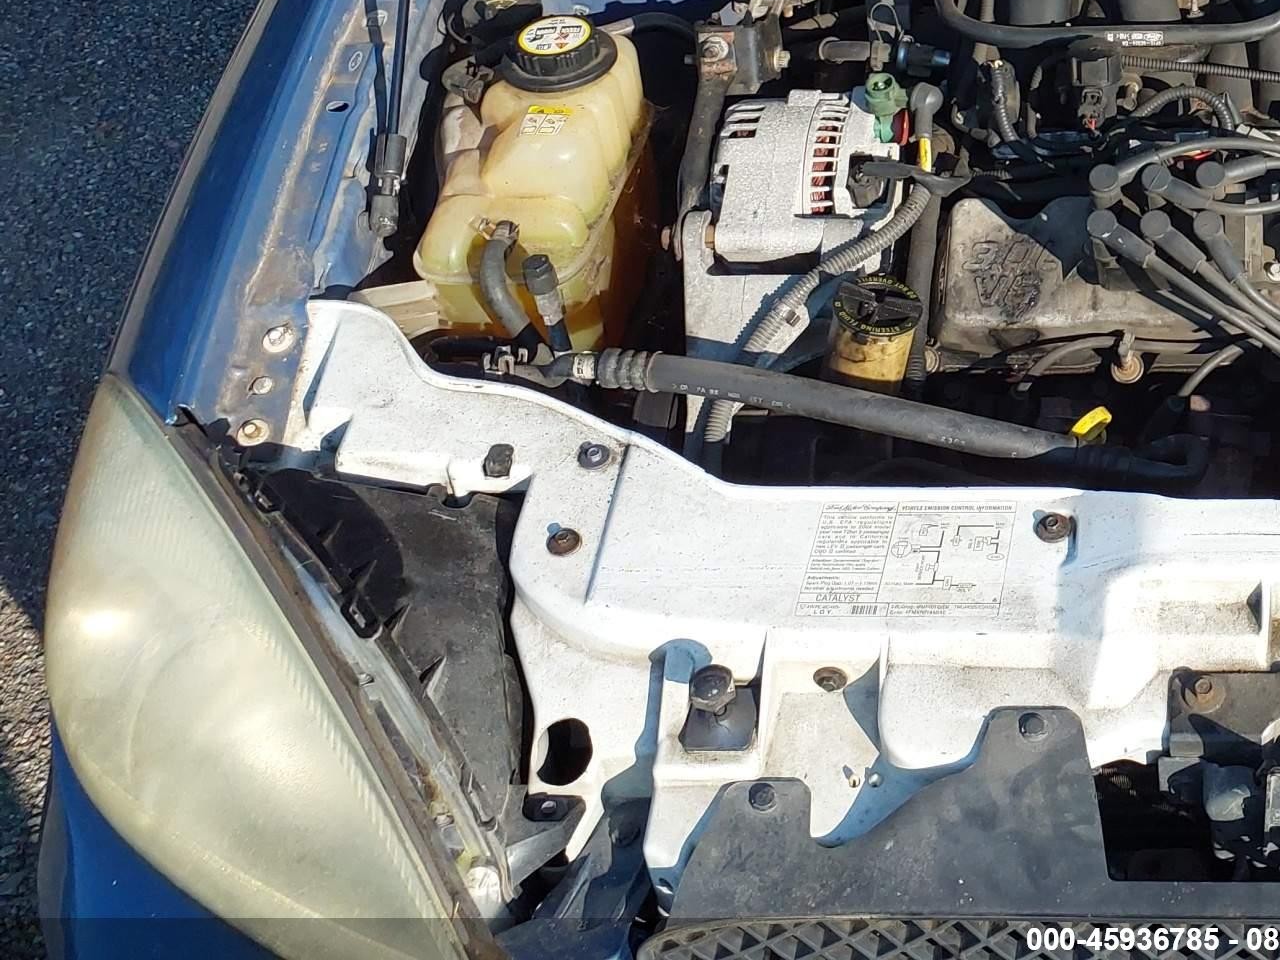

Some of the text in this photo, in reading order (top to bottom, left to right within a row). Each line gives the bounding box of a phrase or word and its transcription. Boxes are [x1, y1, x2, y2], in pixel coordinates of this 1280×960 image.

[838, 311, 901, 333] STEERING FLUID
[815, 593, 861, 602] CATALYST
